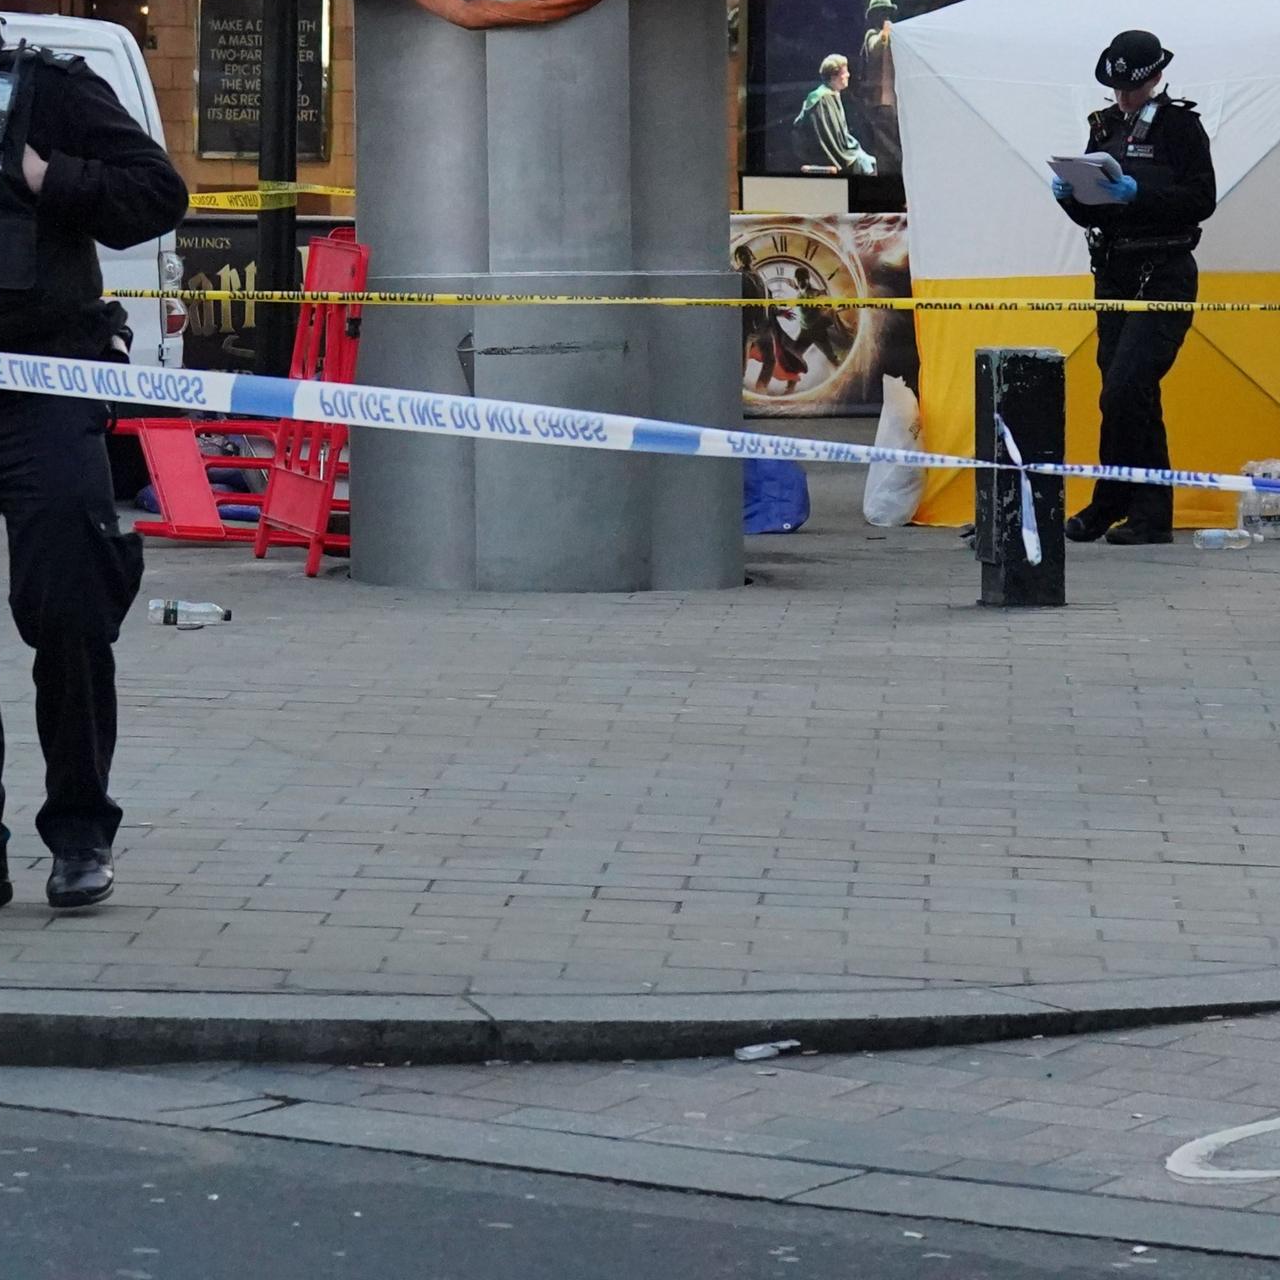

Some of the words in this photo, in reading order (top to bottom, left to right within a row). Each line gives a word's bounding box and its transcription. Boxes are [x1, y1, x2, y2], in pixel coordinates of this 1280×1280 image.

[210, 49, 261, 61] TWO-PAR
[225, 65, 249, 76] EPIC
[221, 79, 242, 91] THE
[214, 94, 237, 105] HAS
[208, 108, 222, 120] ITS
